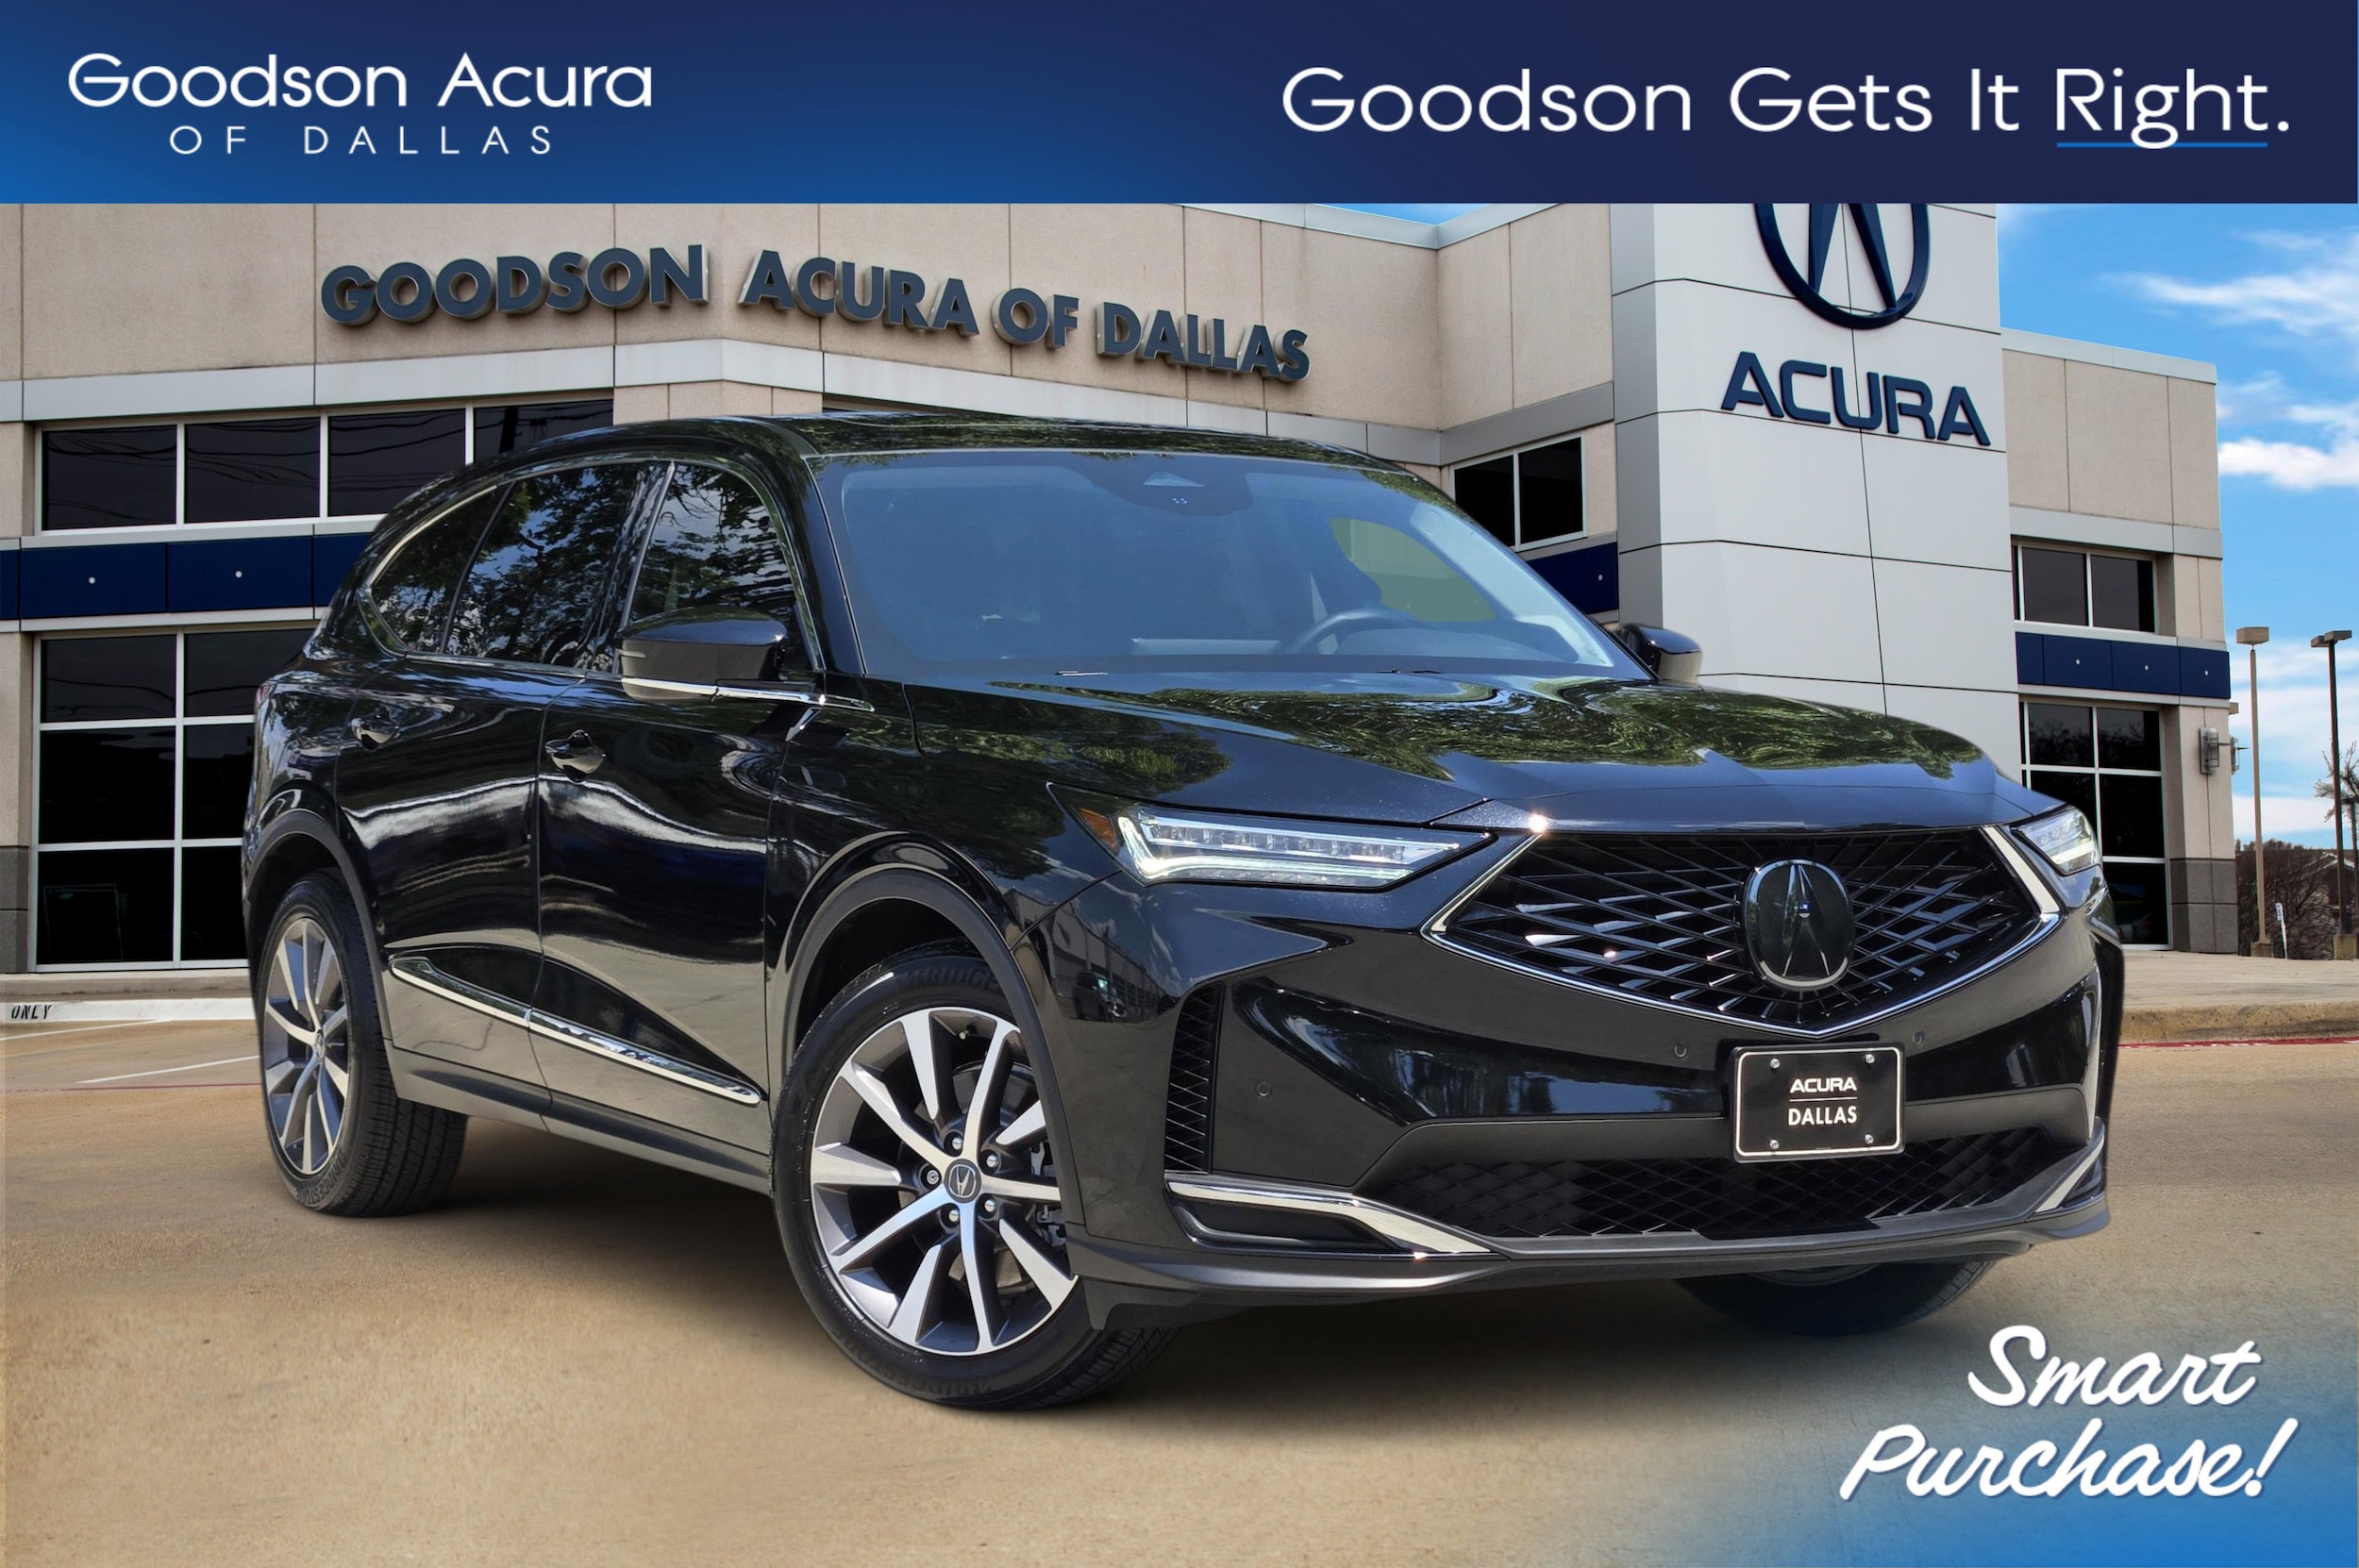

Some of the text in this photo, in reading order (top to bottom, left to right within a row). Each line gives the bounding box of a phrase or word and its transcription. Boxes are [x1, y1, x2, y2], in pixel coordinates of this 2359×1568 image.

[321, 244, 1311, 382] GOODSON ACURA OF DALLAS
[1721, 352, 1990, 445] ACURA
[11, 1004, 52, 1020] ONLY
[1790, 1077, 1858, 1093] ACURA
[1788, 1106, 1858, 1126] DALLAS
